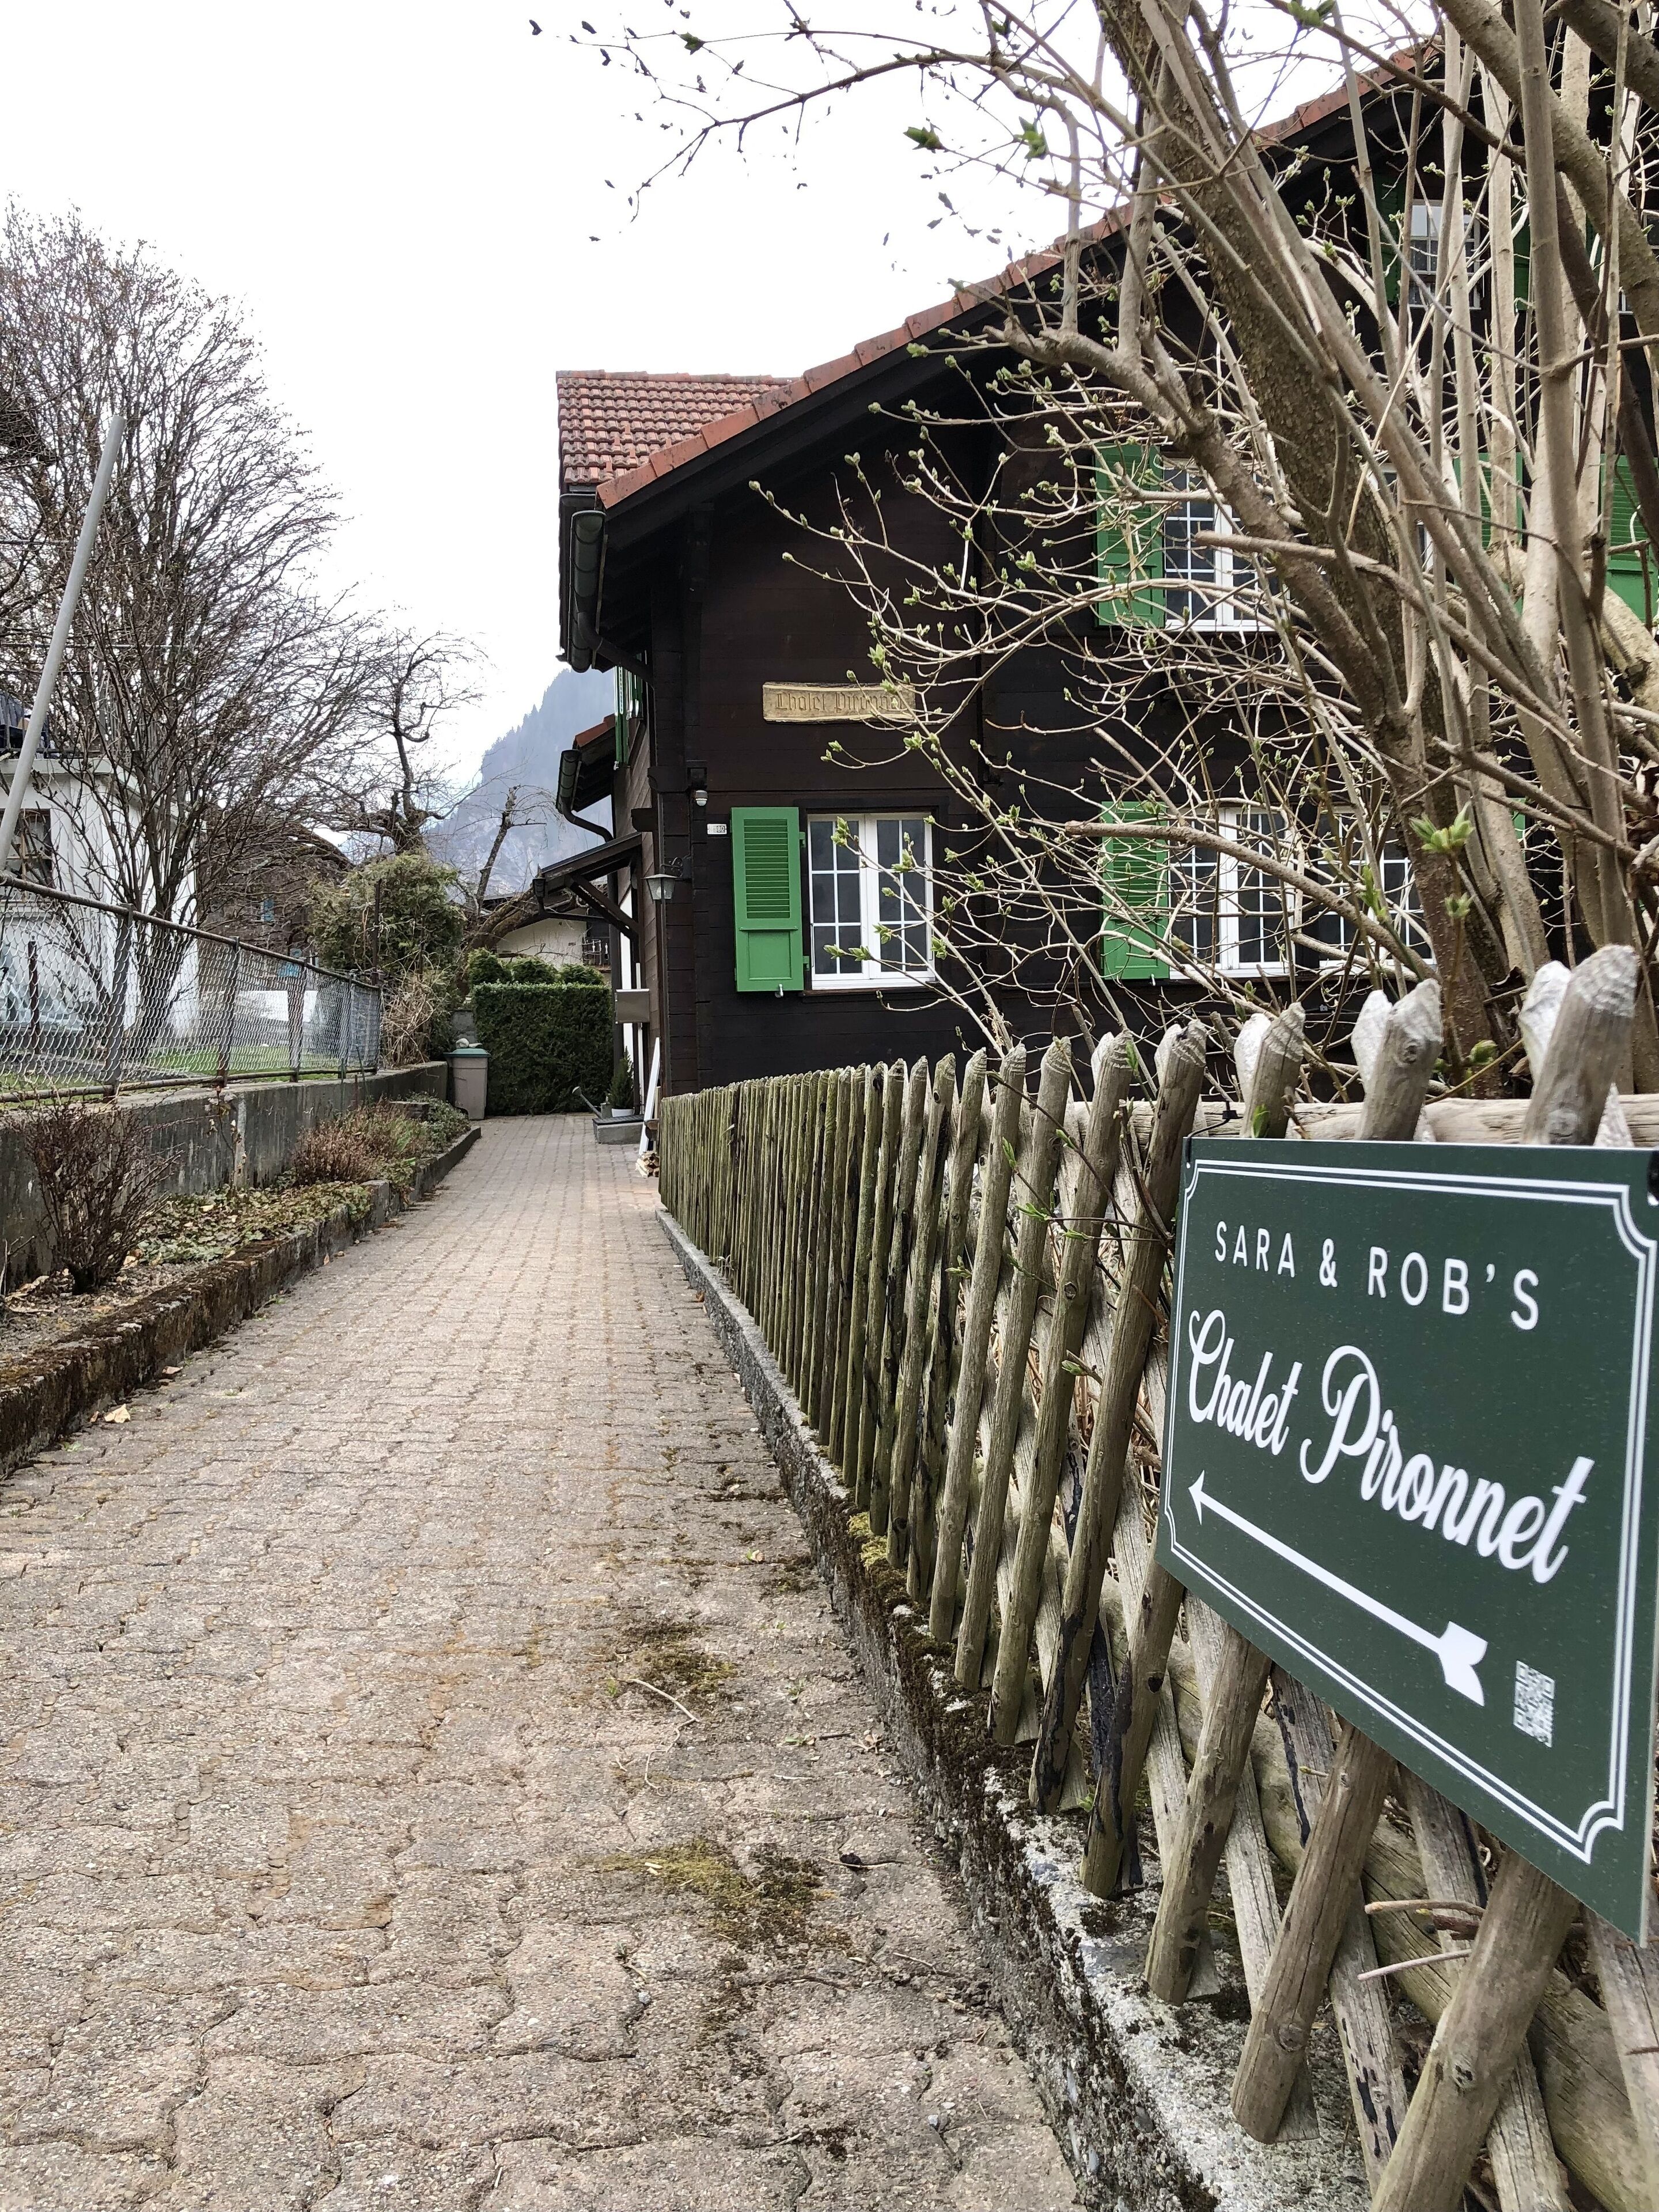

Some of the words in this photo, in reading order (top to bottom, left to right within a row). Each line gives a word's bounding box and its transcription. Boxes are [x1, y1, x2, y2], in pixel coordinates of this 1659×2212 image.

[775, 692, 825, 711] Chalet
[1215, 1221, 1296, 1278] SARA
[1319, 1238, 1338, 1288] &
[1368, 1246, 1539, 1331] ROB'S
[1188, 1309, 1303, 1456] Chalet
[1300, 1345, 1595, 1584] Pironnet
